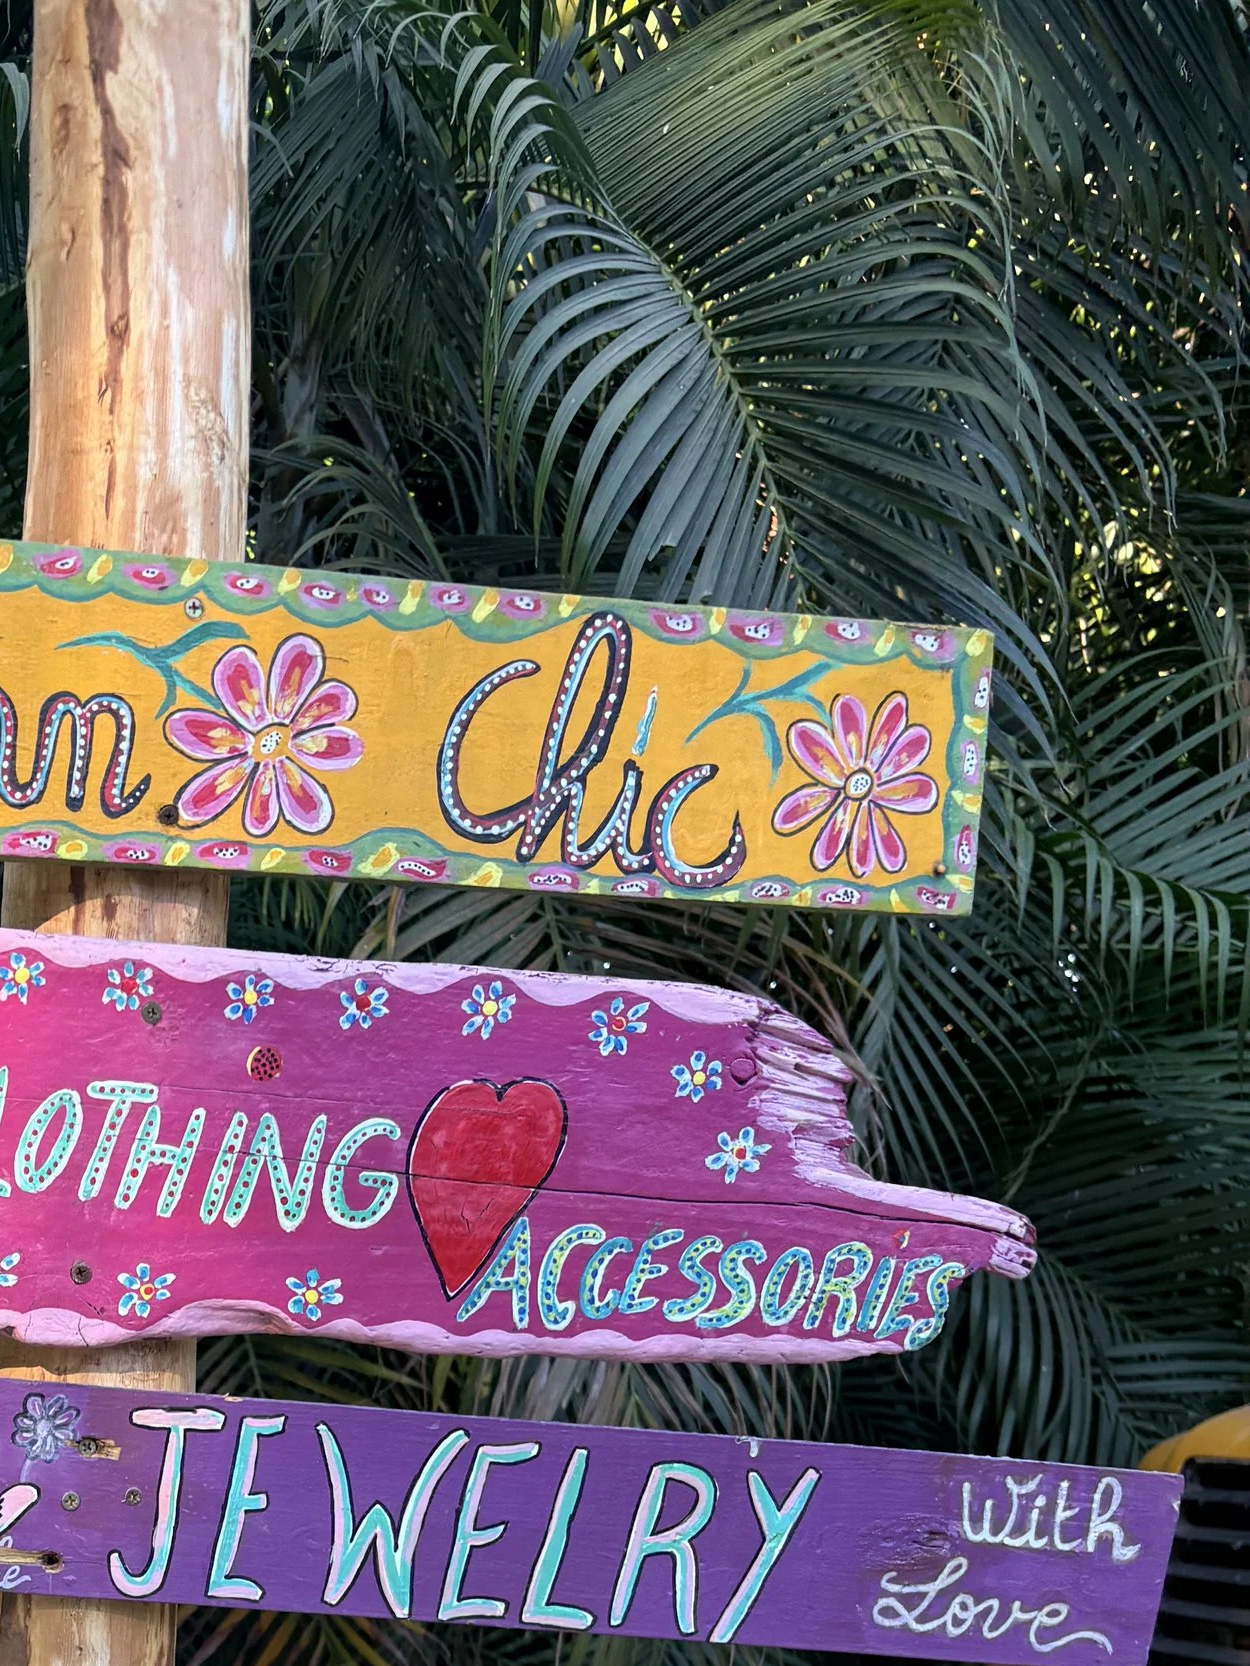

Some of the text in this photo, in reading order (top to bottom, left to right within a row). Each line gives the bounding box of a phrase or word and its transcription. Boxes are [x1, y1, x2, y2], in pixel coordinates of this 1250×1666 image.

[437, 612, 746, 888] Chic
[108, 1407, 820, 1644] JEWELRY
[962, 1474, 1142, 1562] With
[872, 1556, 1114, 1656] Love
